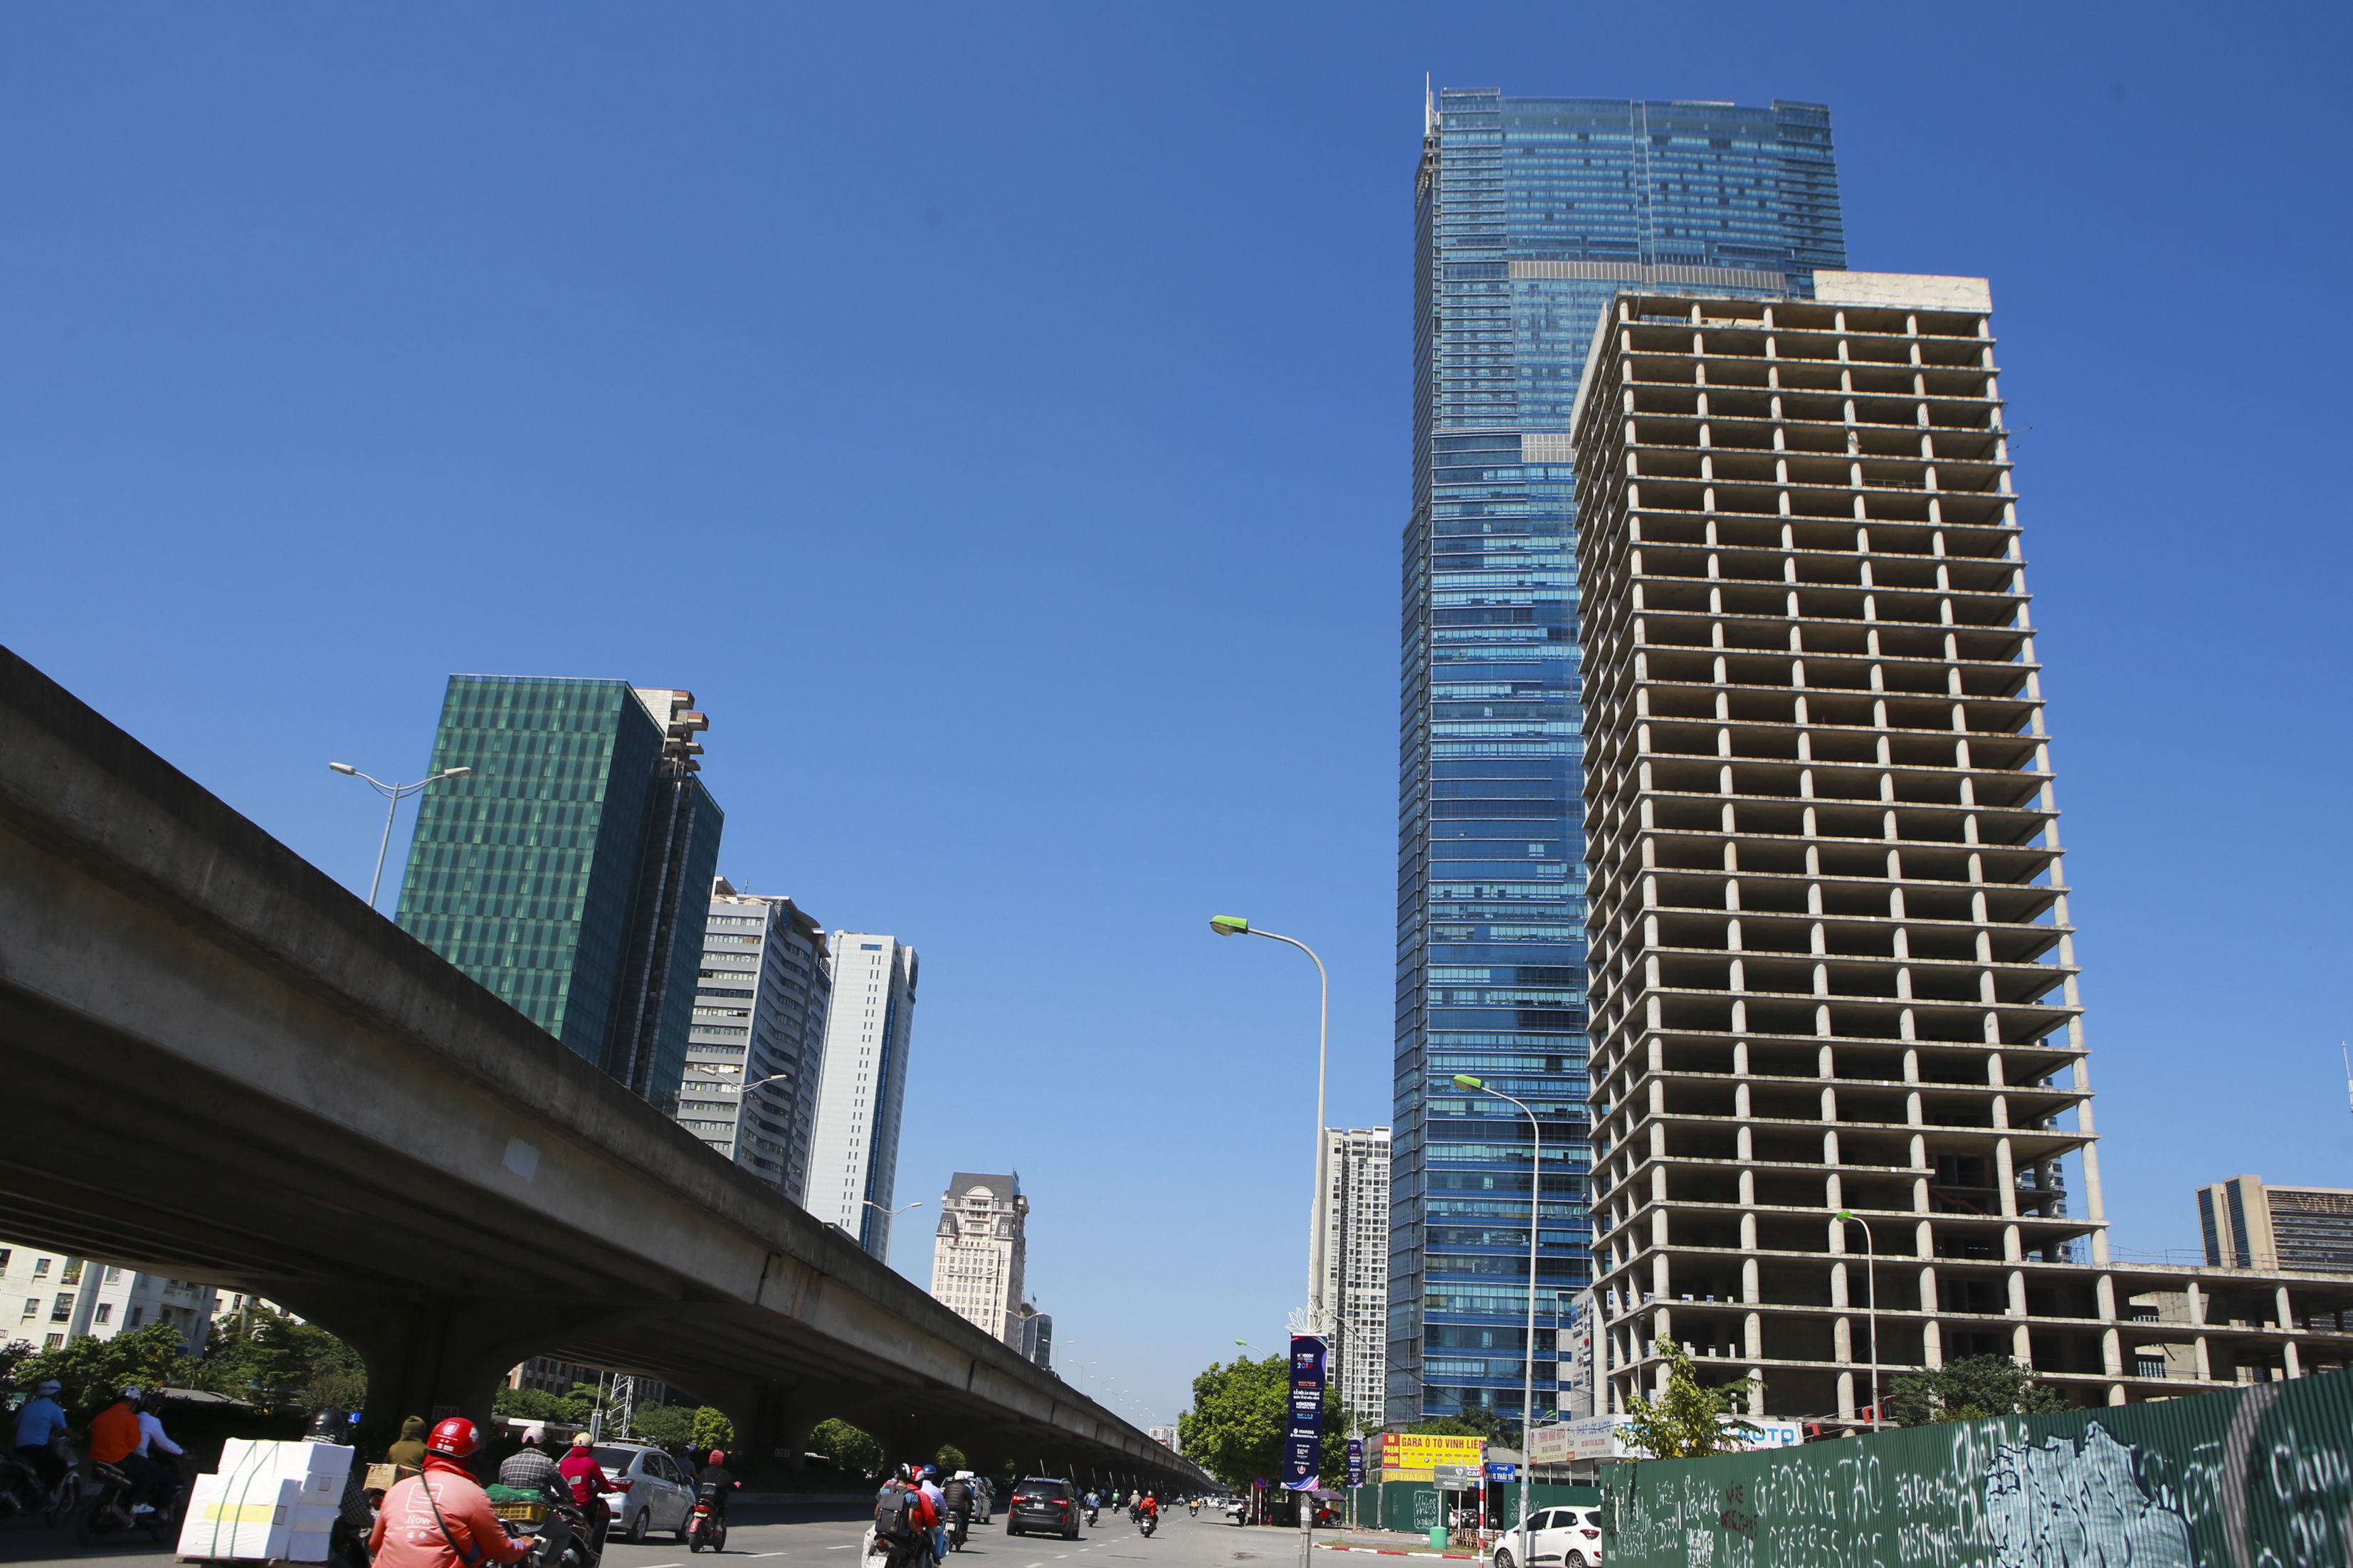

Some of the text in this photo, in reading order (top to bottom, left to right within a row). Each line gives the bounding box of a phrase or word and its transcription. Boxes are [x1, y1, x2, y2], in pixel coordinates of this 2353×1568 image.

[1401, 1437, 1422, 1448] GARA
[1425, 1436, 1431, 1448] Ô
[1433, 1436, 1443, 1448] TÔ
[1446, 1438, 1464, 1449] VINH
[1384, 1453, 1399, 1464] HÙNG
[406, 1515, 433, 1525] Now
